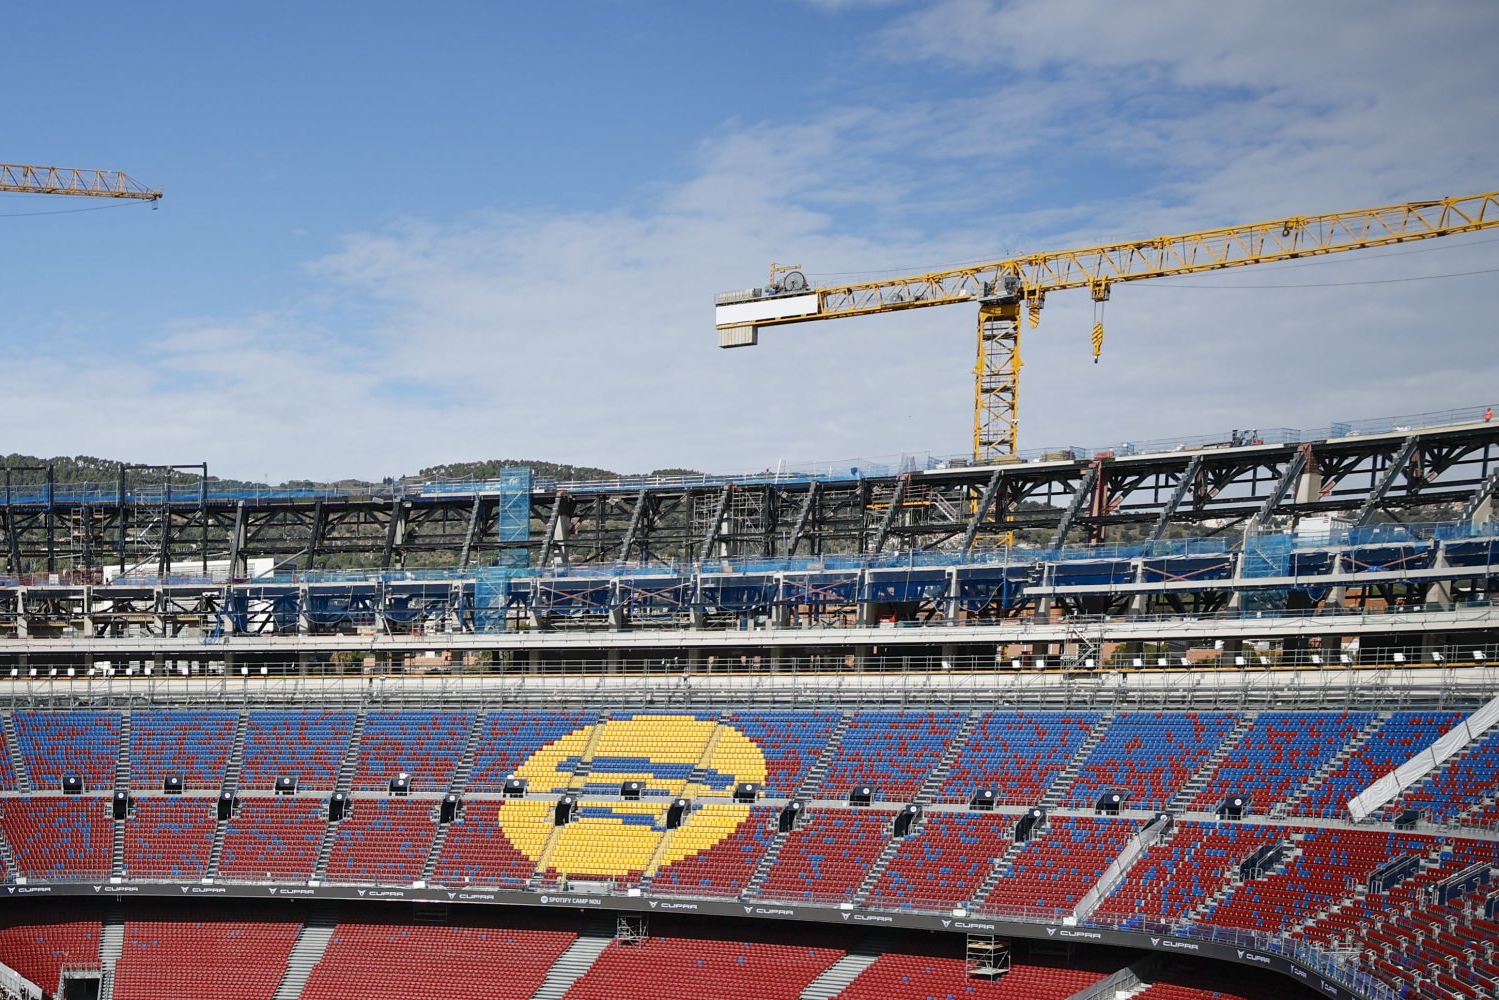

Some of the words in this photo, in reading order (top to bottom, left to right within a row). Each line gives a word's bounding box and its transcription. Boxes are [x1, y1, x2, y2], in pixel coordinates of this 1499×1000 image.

[954, 922, 995, 930] CUPRA
[1060, 930, 1101, 939] CUPRA
[1163, 940, 1198, 950] CUPRA
[1246, 953, 1270, 964] CUPRA
